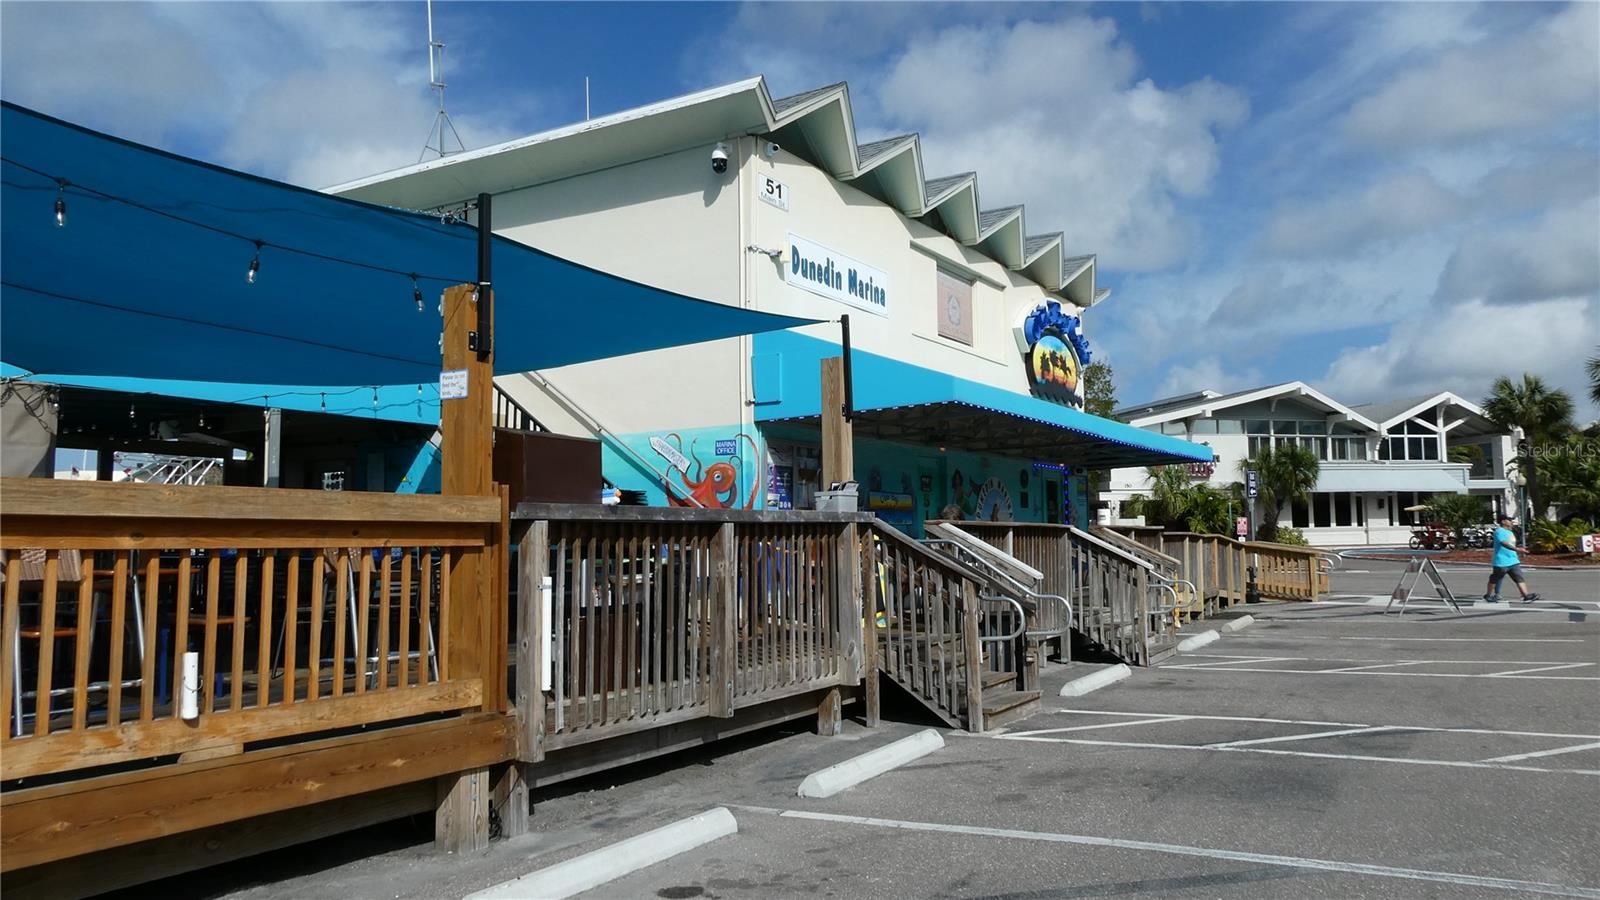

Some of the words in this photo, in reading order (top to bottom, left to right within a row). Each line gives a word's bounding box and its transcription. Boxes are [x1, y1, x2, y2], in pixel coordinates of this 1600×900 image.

[766, 178, 782, 199] 51
[792, 245, 842, 291] Dunedin
[848, 268, 885, 307] Marina
